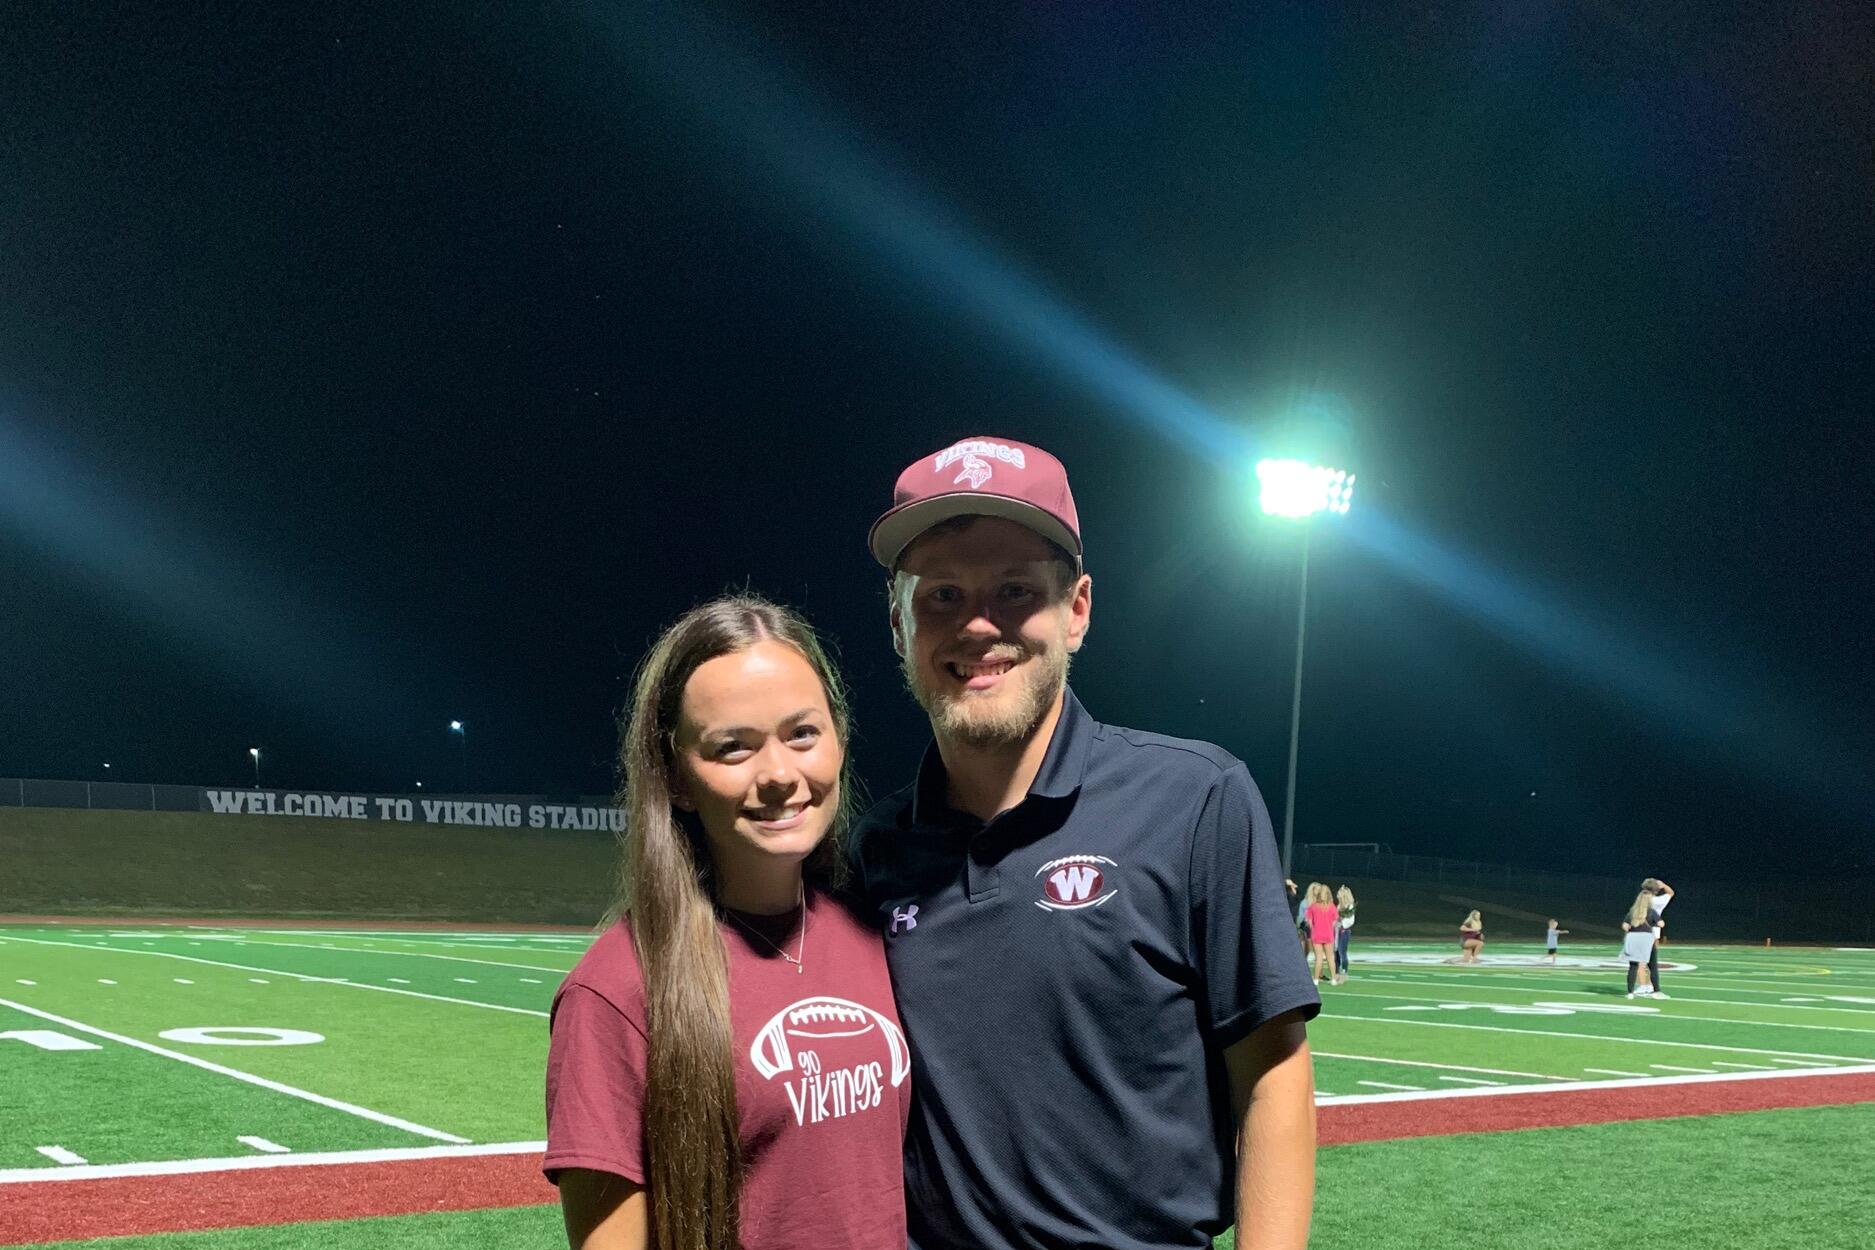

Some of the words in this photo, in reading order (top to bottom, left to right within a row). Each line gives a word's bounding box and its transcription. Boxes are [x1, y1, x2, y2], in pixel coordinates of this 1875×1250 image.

[207, 790, 367, 820] WELCOME
[376, 798, 413, 822] TO
[421, 800, 522, 828] VIKING
[529, 804, 630, 832] STADIU
[1050, 866, 1099, 902] W
[784, 1061, 884, 1126] Vikings
